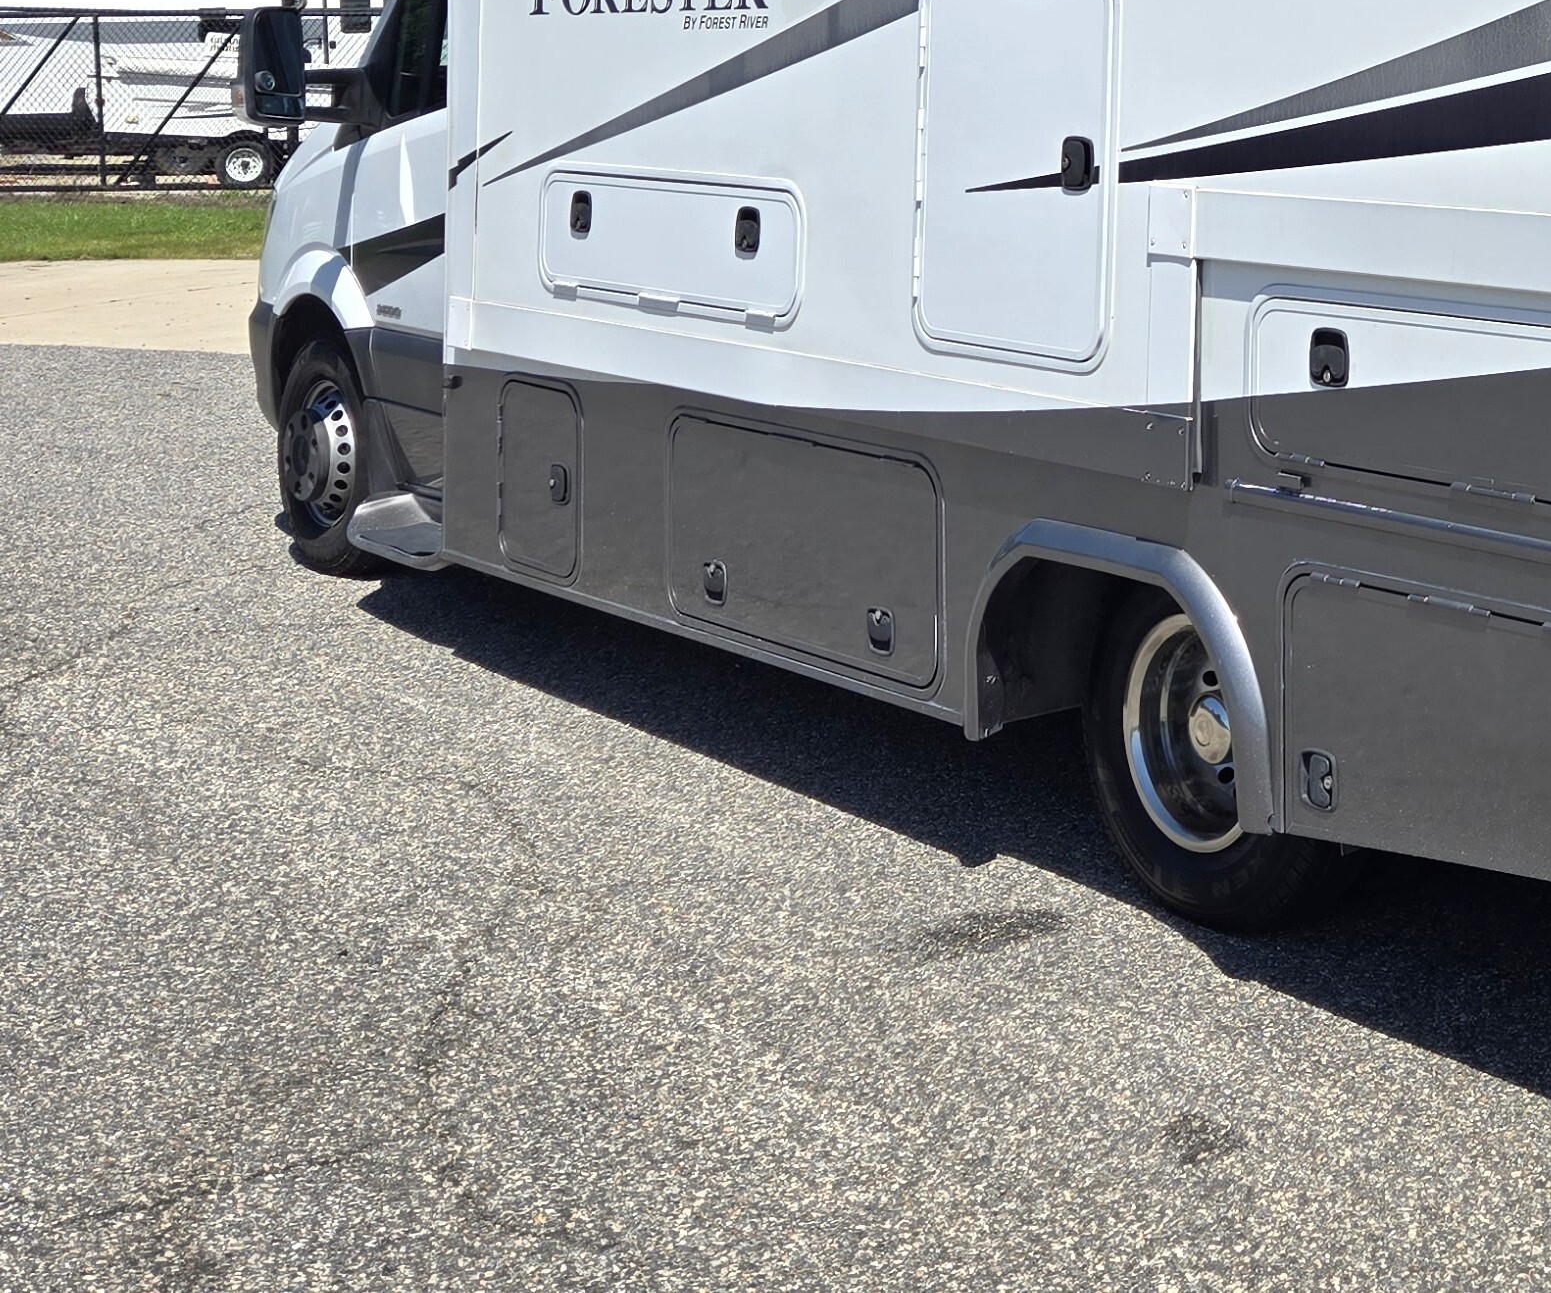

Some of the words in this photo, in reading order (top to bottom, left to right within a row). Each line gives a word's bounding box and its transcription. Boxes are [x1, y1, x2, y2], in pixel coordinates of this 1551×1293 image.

[683, 15, 698, 30] BY
[698, 14, 738, 30] FOREST
[739, 13, 769, 29] RIVER
